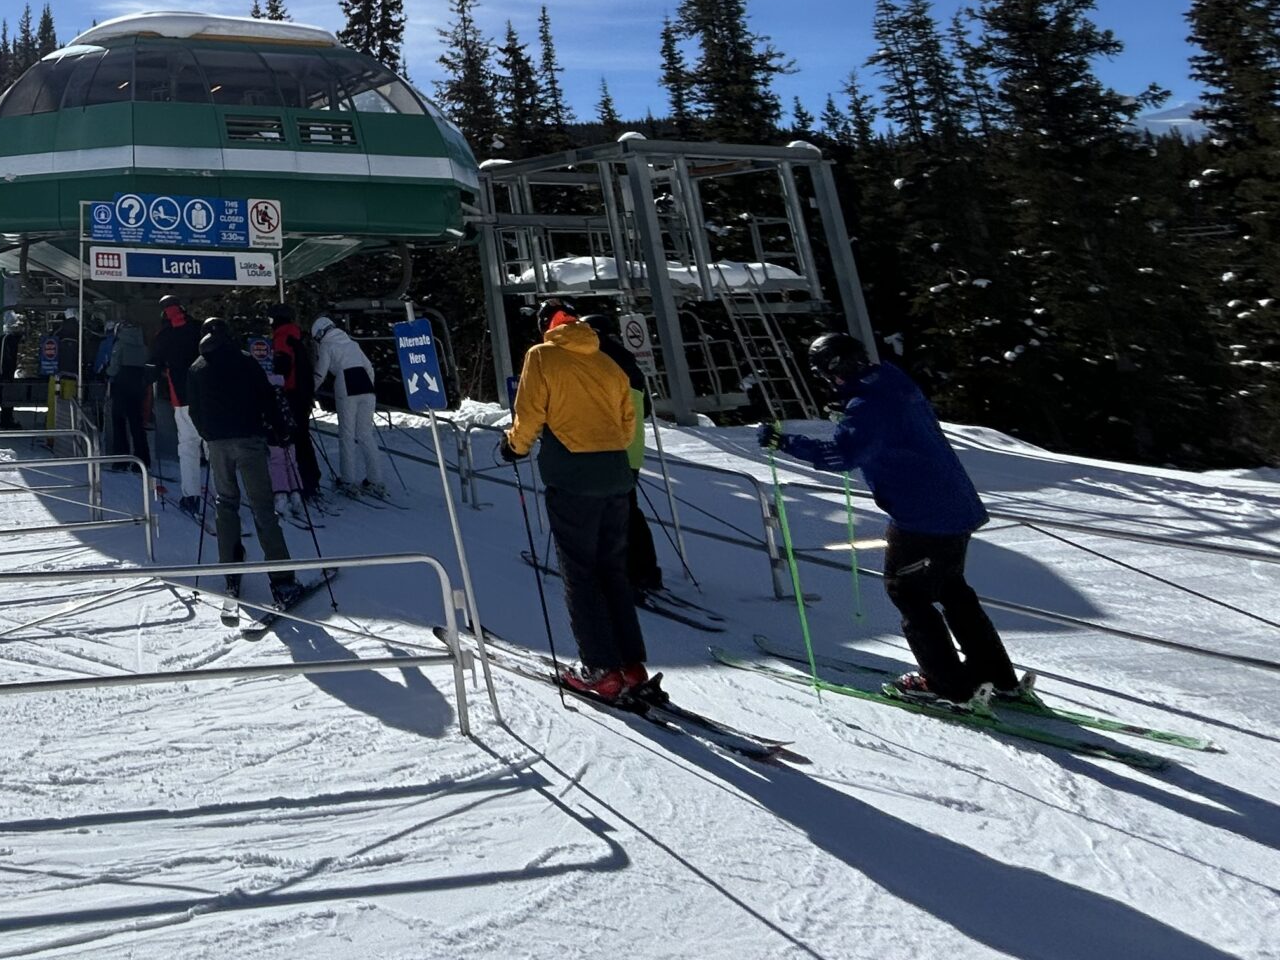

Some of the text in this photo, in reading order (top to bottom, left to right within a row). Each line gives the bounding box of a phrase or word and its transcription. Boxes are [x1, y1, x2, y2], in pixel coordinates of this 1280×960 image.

[224, 200, 239, 208] THIS
[219, 215, 244, 223] CLOSED
[162, 257, 201, 275] Larch
[239, 261, 259, 271] Lake
[247, 268, 272, 277] Louise
[399, 334, 431, 348] Alternate
[408, 352, 426, 364] Here
